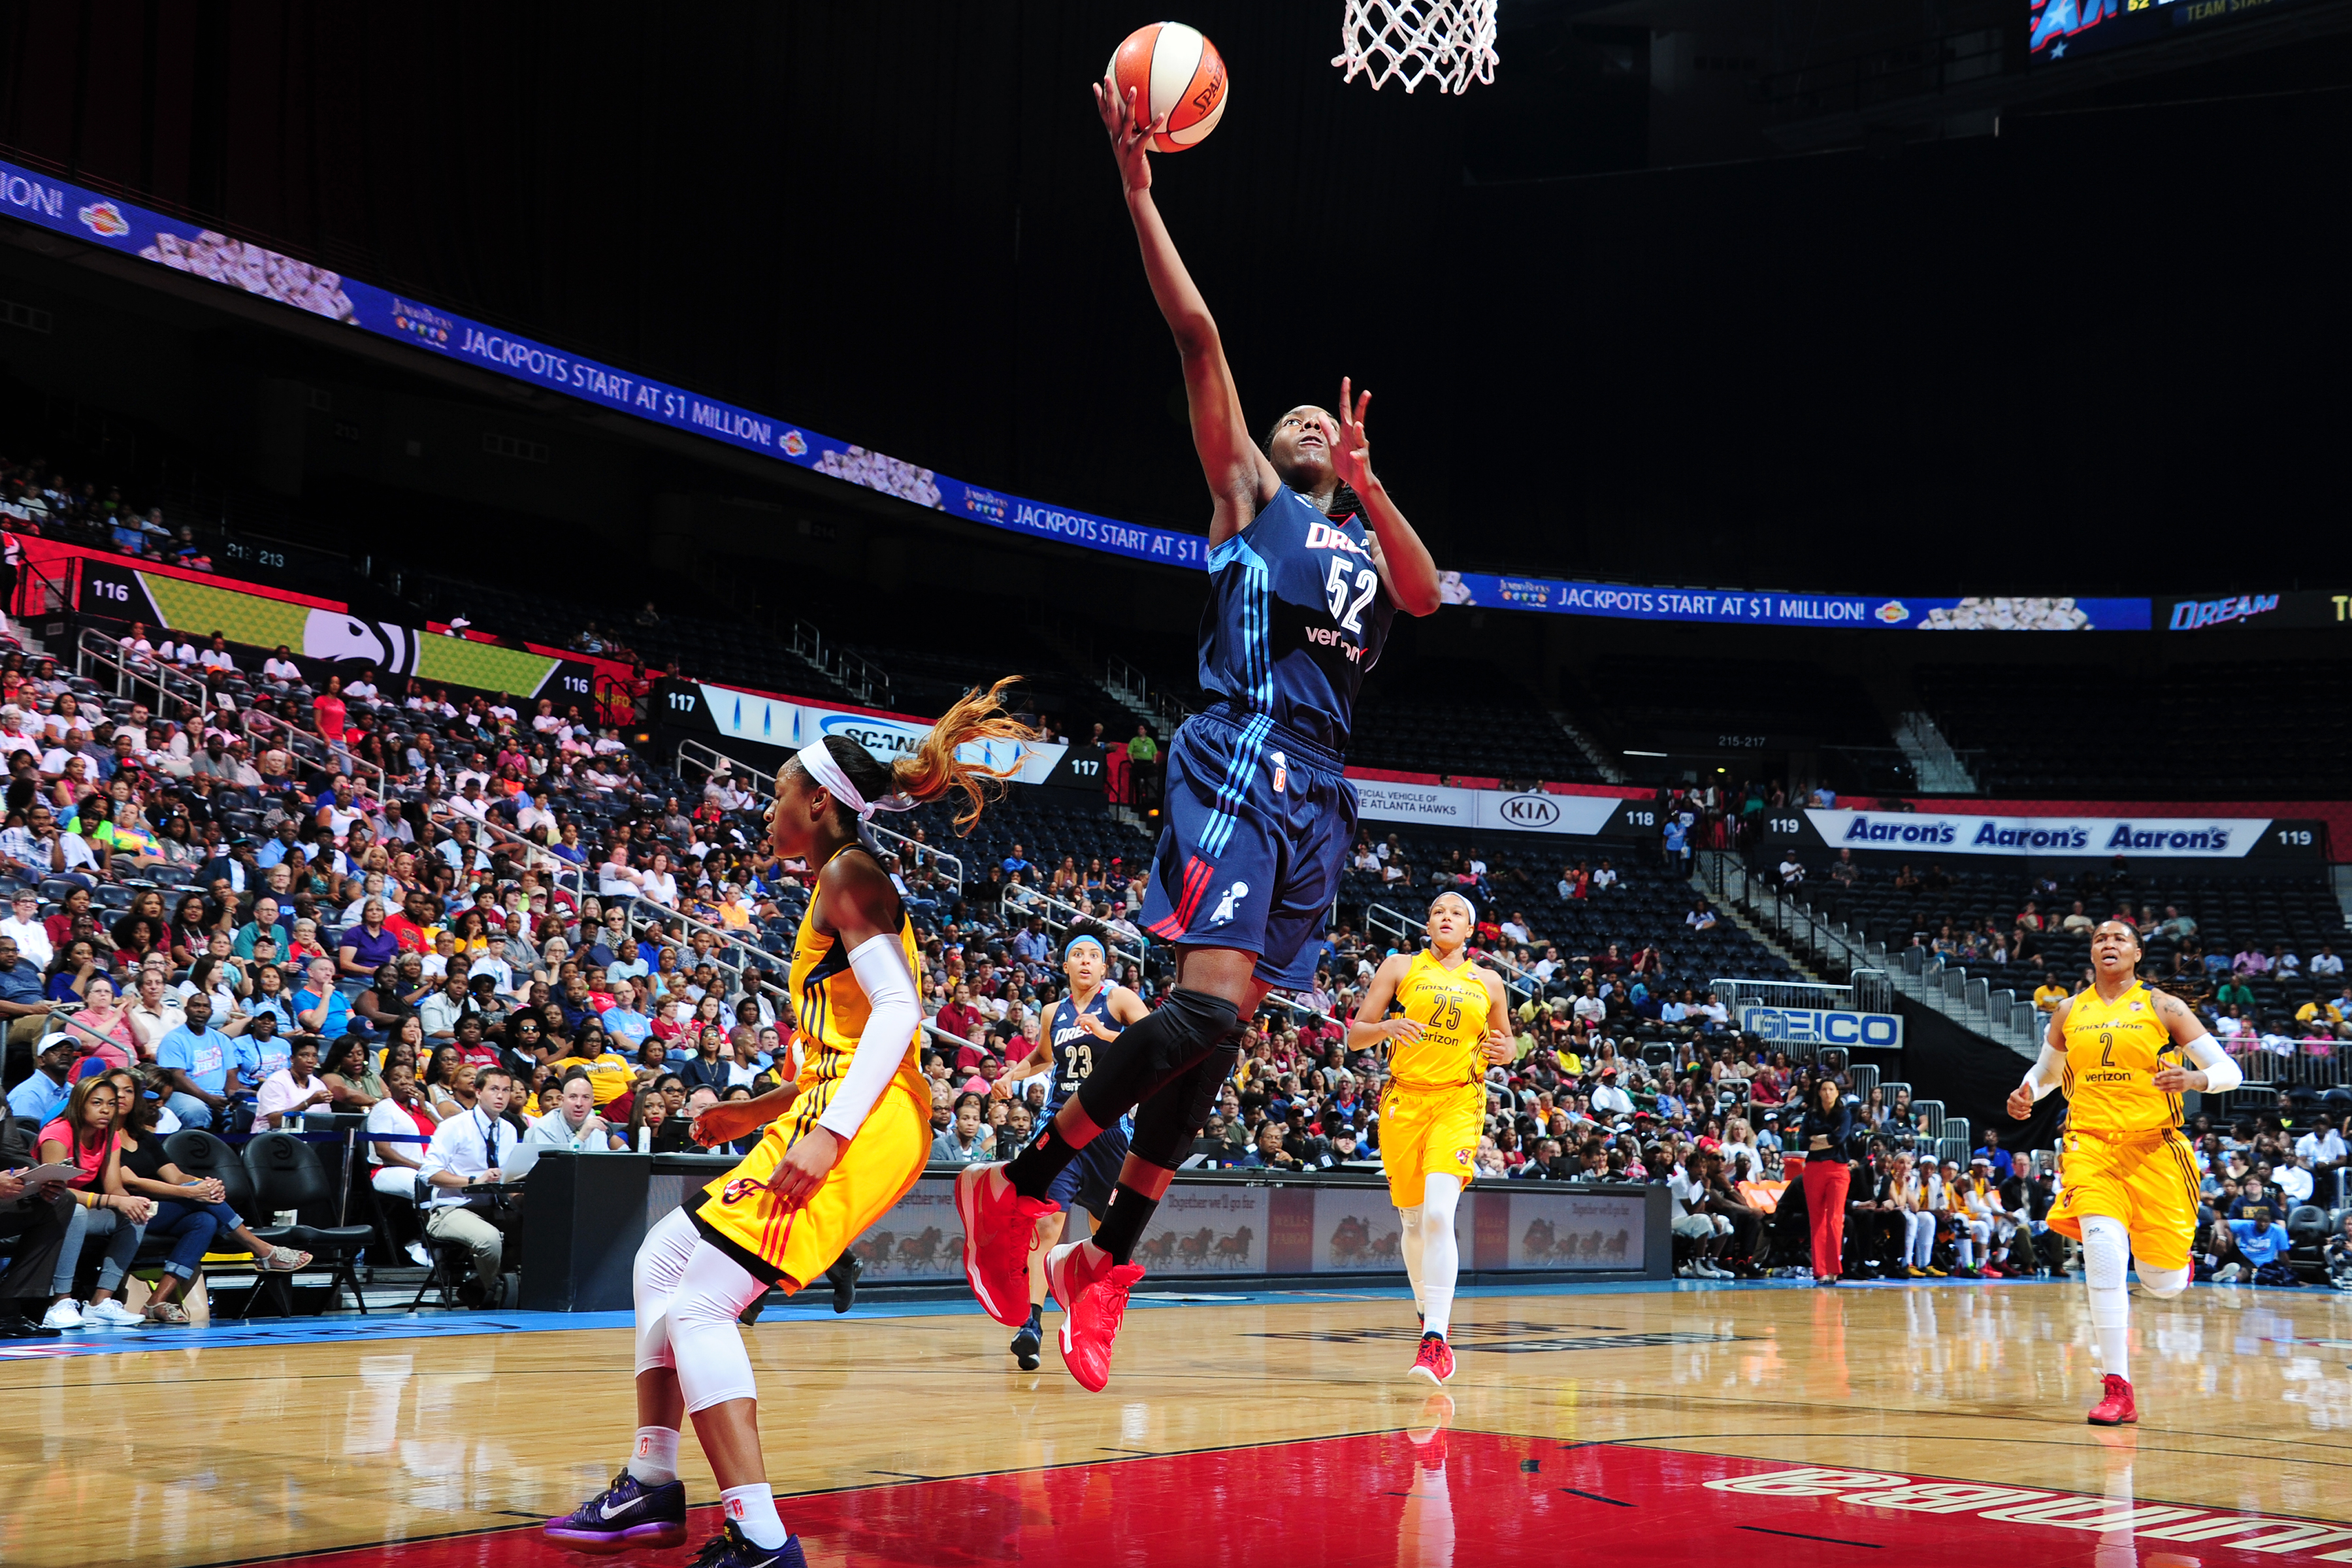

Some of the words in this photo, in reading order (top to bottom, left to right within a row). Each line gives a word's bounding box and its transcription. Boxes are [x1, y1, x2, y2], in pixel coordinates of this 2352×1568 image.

[2187, 1, 2227, 22] TEAM
[460, 327, 568, 382] JACKPOTS
[572, 363, 633, 402] START
[635, 385, 661, 411] AT
[664, 391, 685, 420] $1
[692, 401, 772, 446] MILLION!
[1013, 504, 1097, 541] JACKPOTS
[1100, 524, 1148, 551] START
[1151, 535, 1174, 556] AT
[1177, 538, 1198, 561] $1
[259, 550, 285, 568] 213
[93, 580, 129, 602] 116
[1326, 555, 1378, 635] 52
[1558, 587, 1654, 612] JACKPOTS
[1658, 594, 1716, 615] START
[1720, 597, 1745, 615] AT
[1750, 597, 1771, 618] $1
[1780, 600, 1865, 621] MILLION!
[2169, 594, 2279, 630] DREAM
[564, 676, 589, 694] 116
[668, 692, 695, 712] 117
[1718, 735, 1766, 747] 215-217
[1071, 759, 1099, 776] 117
[1370, 799, 1416, 811] ATLANTA
[1419, 804, 1457, 815] HAWKS
[1388, 792, 1424, 802] VEHICLE
[1426, 794, 1437, 803] OF
[1511, 802, 1550, 821] KIA
[1626, 811, 1654, 826] 118
[1769, 818, 1799, 833] 119
[1844, 816, 1956, 843] Aaron's
[1973, 821, 2088, 849] Aaron's
[2106, 825, 2230, 849] Aaron's
[2278, 830, 2312, 845] 119
[1428, 994, 1463, 1030] 25
[1744, 1009, 1897, 1045] GEICO
[1418, 1031, 1458, 1047] erizon
[2099, 1032, 2115, 1067] 2
[1065, 1045, 1093, 1079] 23
[2085, 1071, 2131, 1083] verizon
[122, 1321, 523, 1343] Grady
